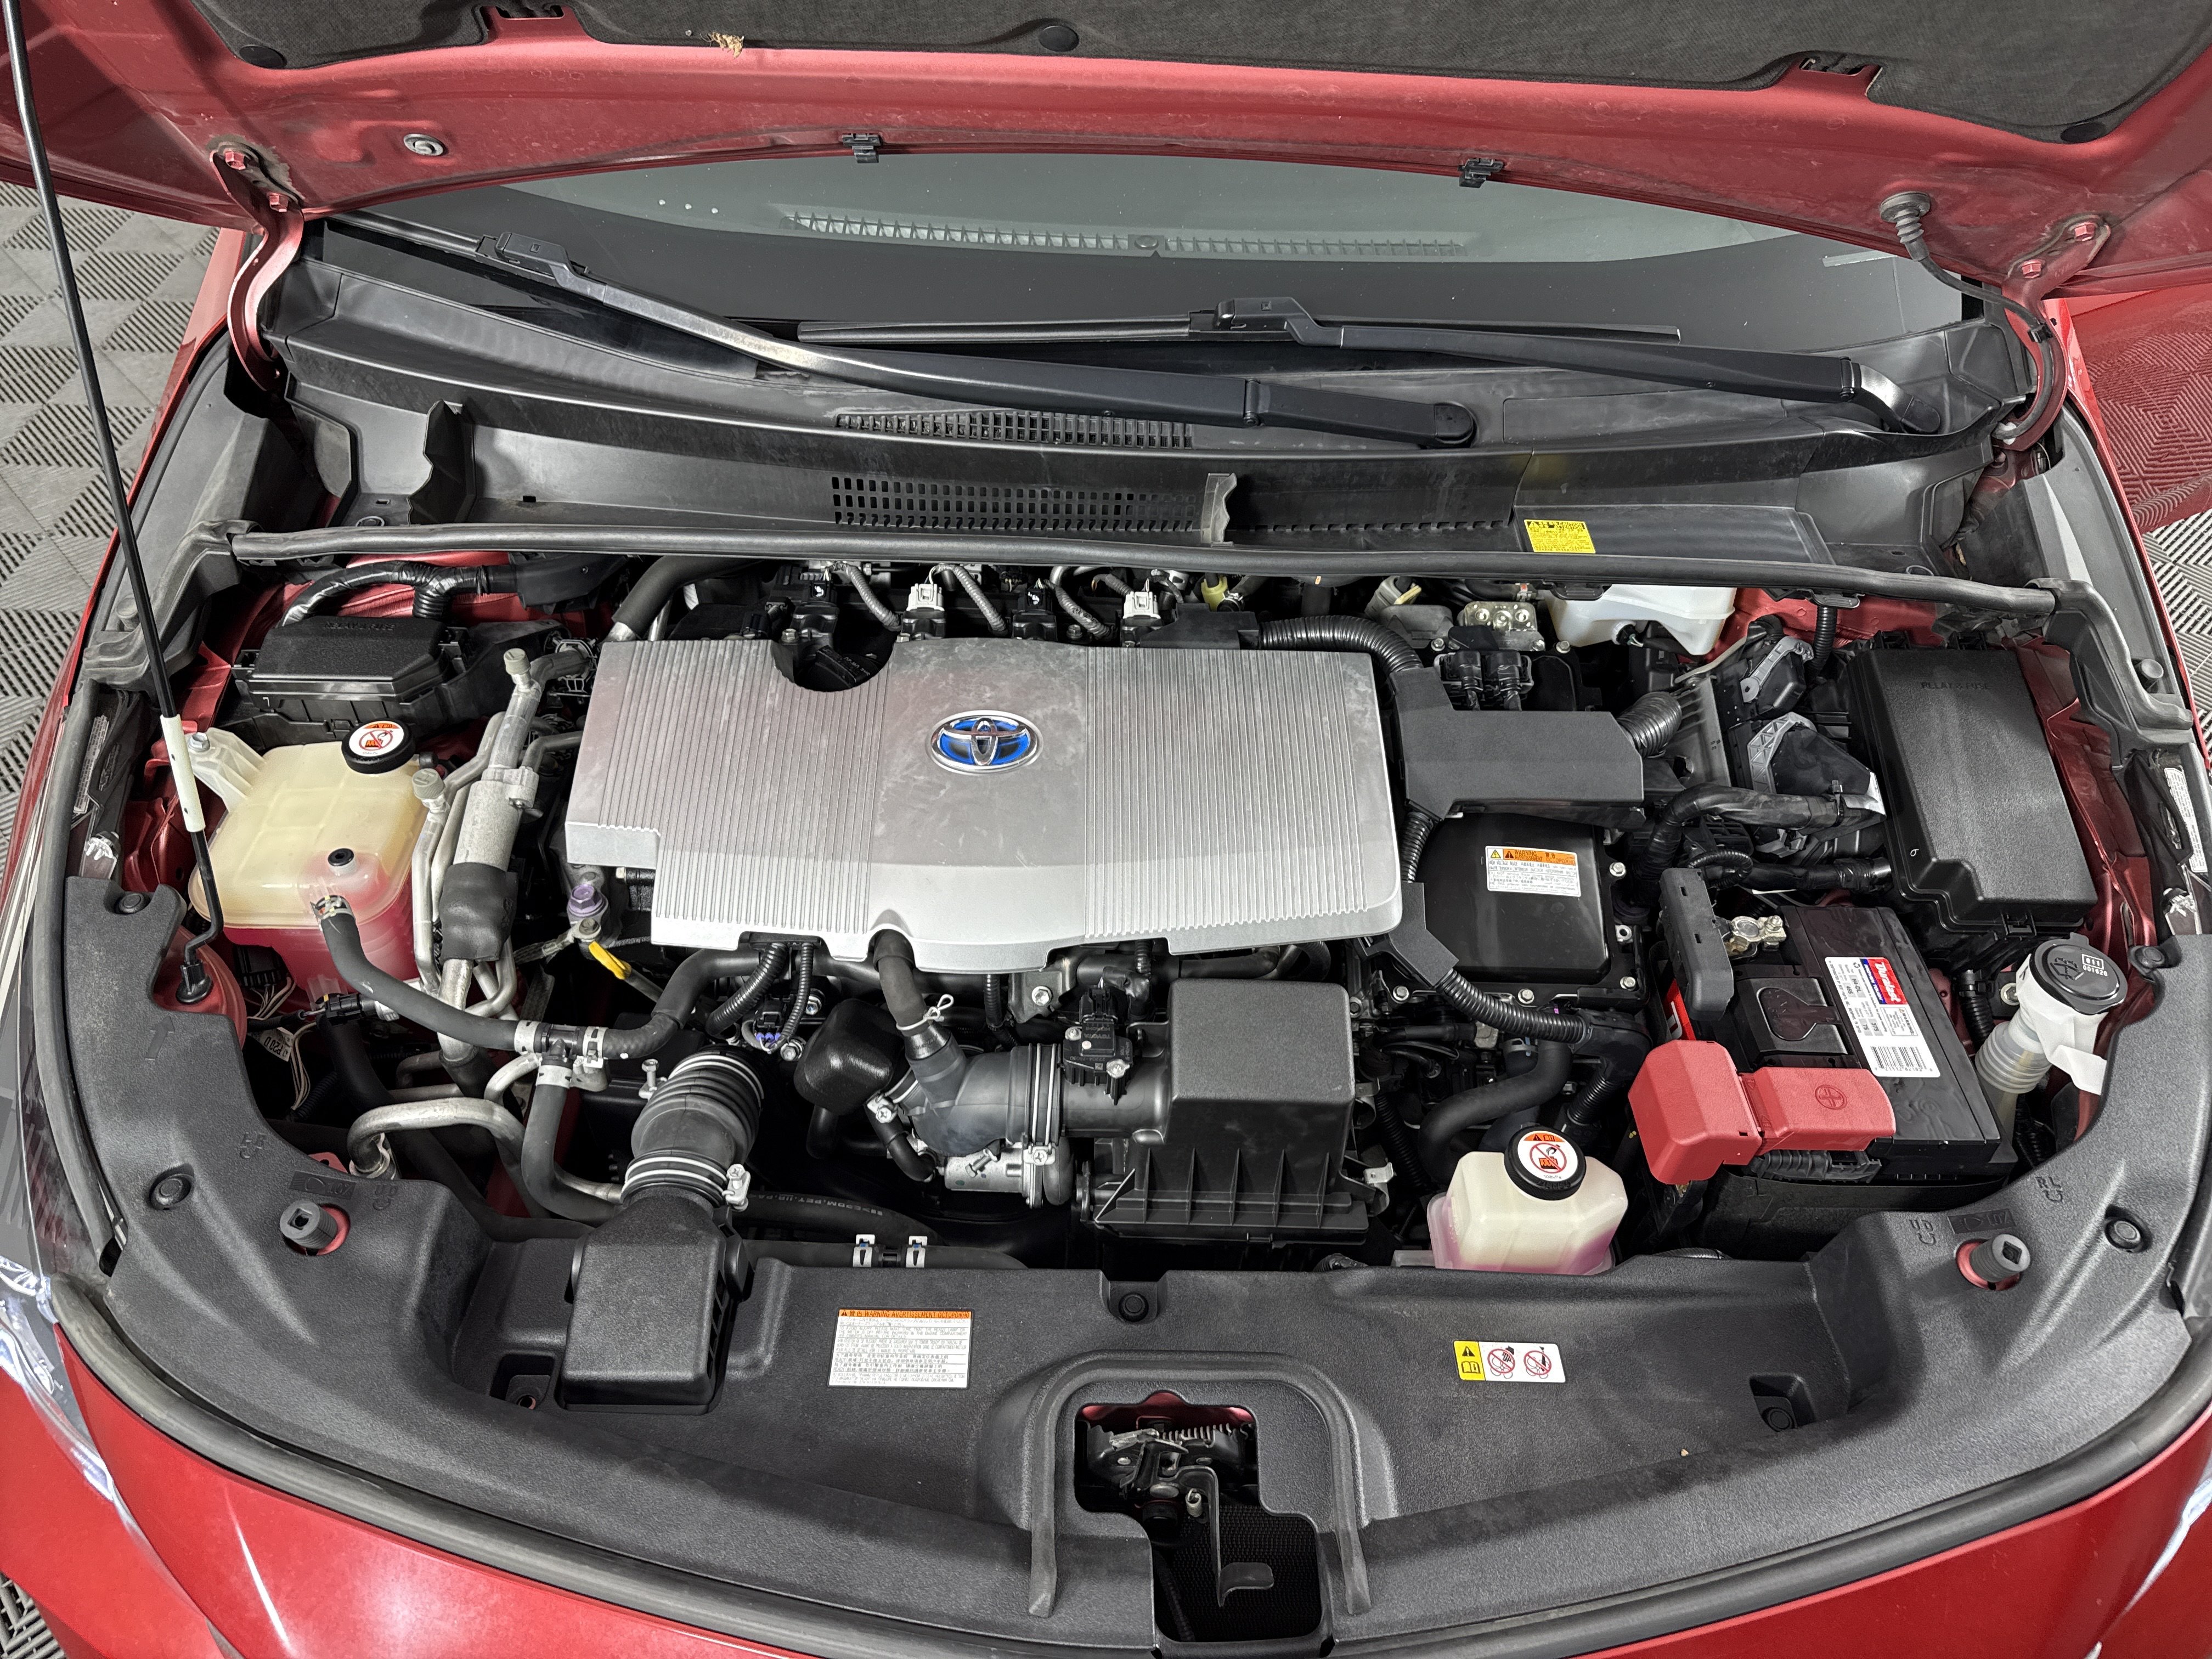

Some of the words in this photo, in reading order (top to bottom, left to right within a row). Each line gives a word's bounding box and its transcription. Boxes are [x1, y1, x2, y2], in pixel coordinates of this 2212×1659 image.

[1852, 978, 1861, 992] H4-DL
[1875, 961, 1903, 1002] Duralast
[2034, 1176, 2061, 1189] RL
[1908, 1218, 1933, 1231] UD
